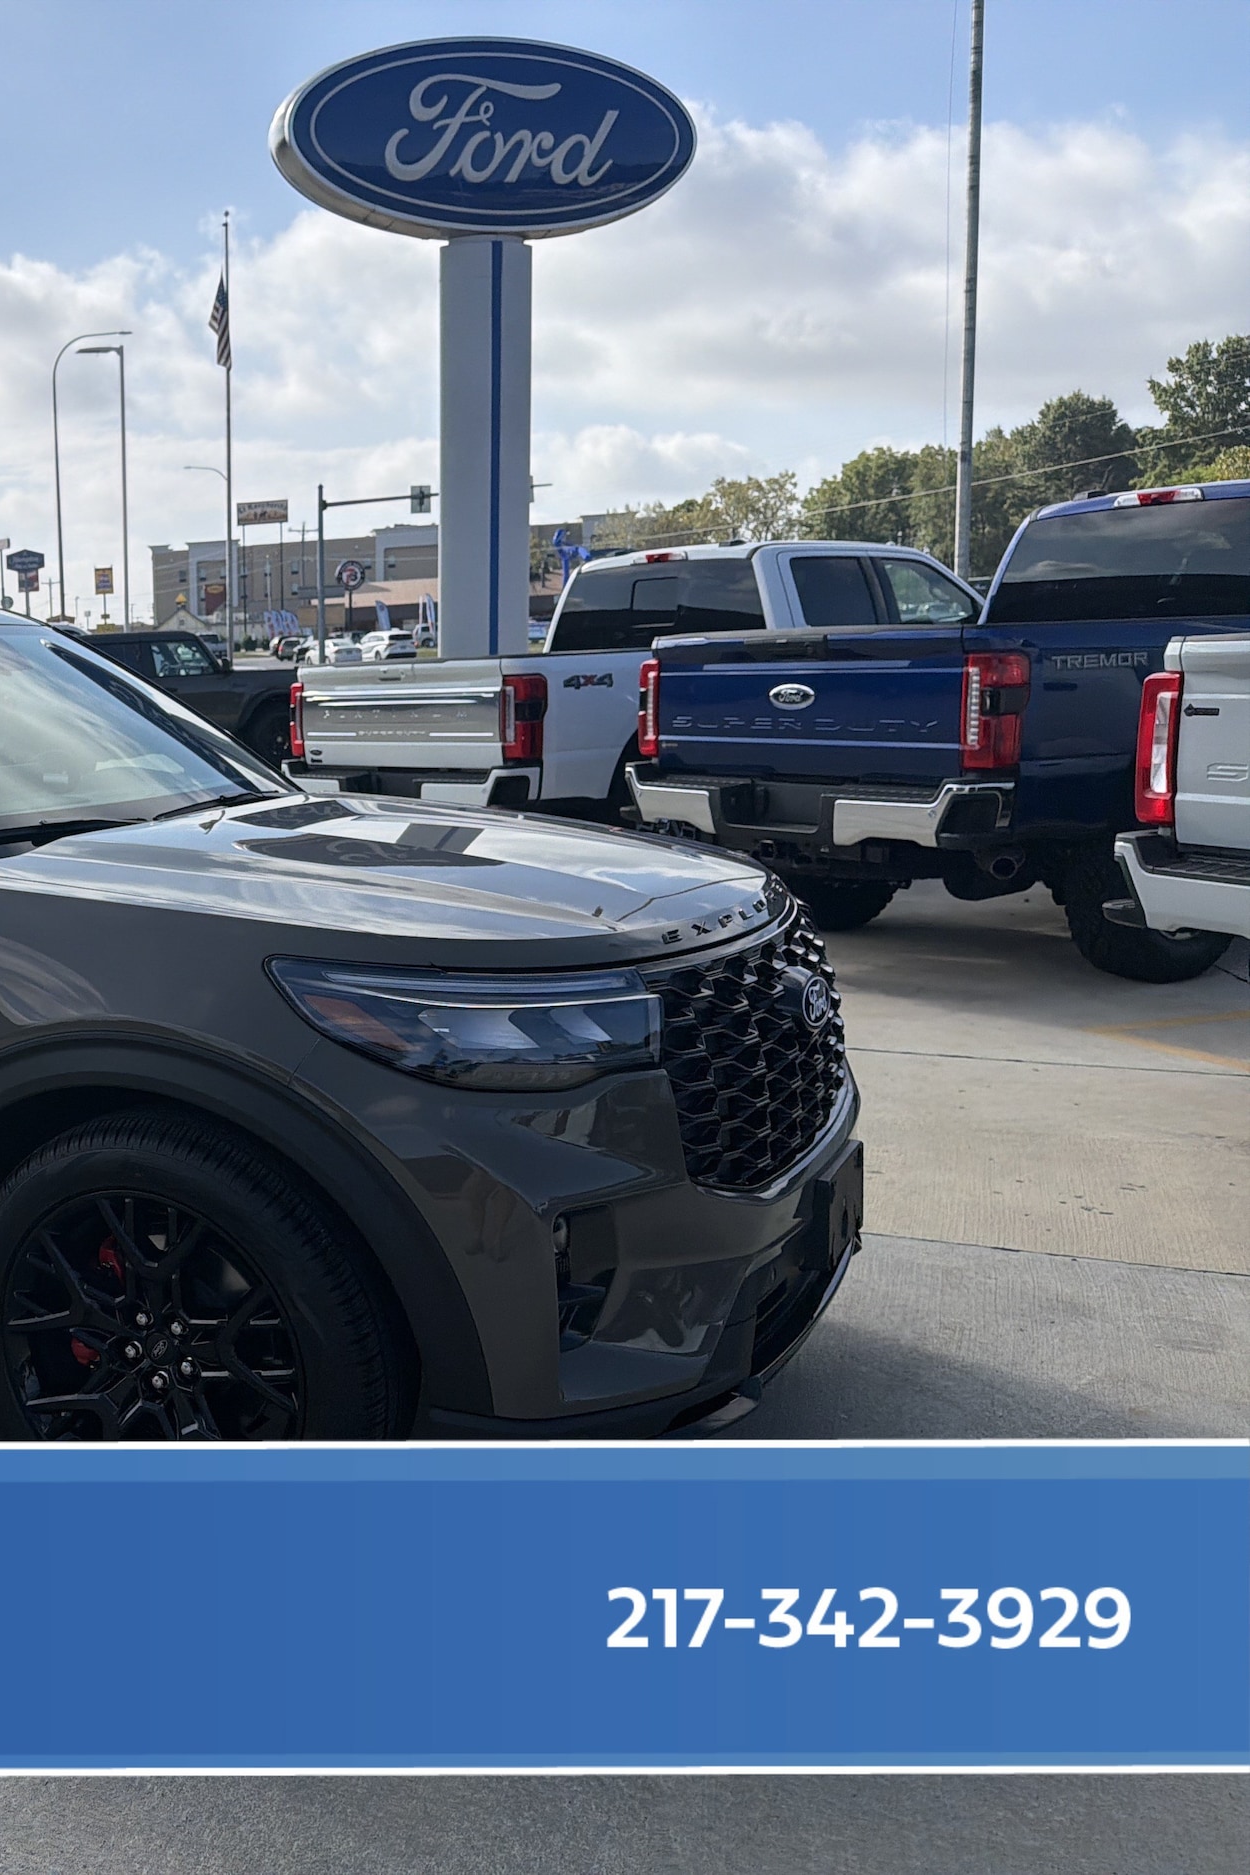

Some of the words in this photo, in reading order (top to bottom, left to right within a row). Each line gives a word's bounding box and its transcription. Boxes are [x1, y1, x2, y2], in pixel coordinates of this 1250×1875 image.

[385, 73, 619, 187] Ford
[1051, 651, 1150, 670] TREMOR
[672, 715, 802, 731] SUPER
[814, 717, 938, 733] DUTY
[808, 982, 828, 1022] Ford
